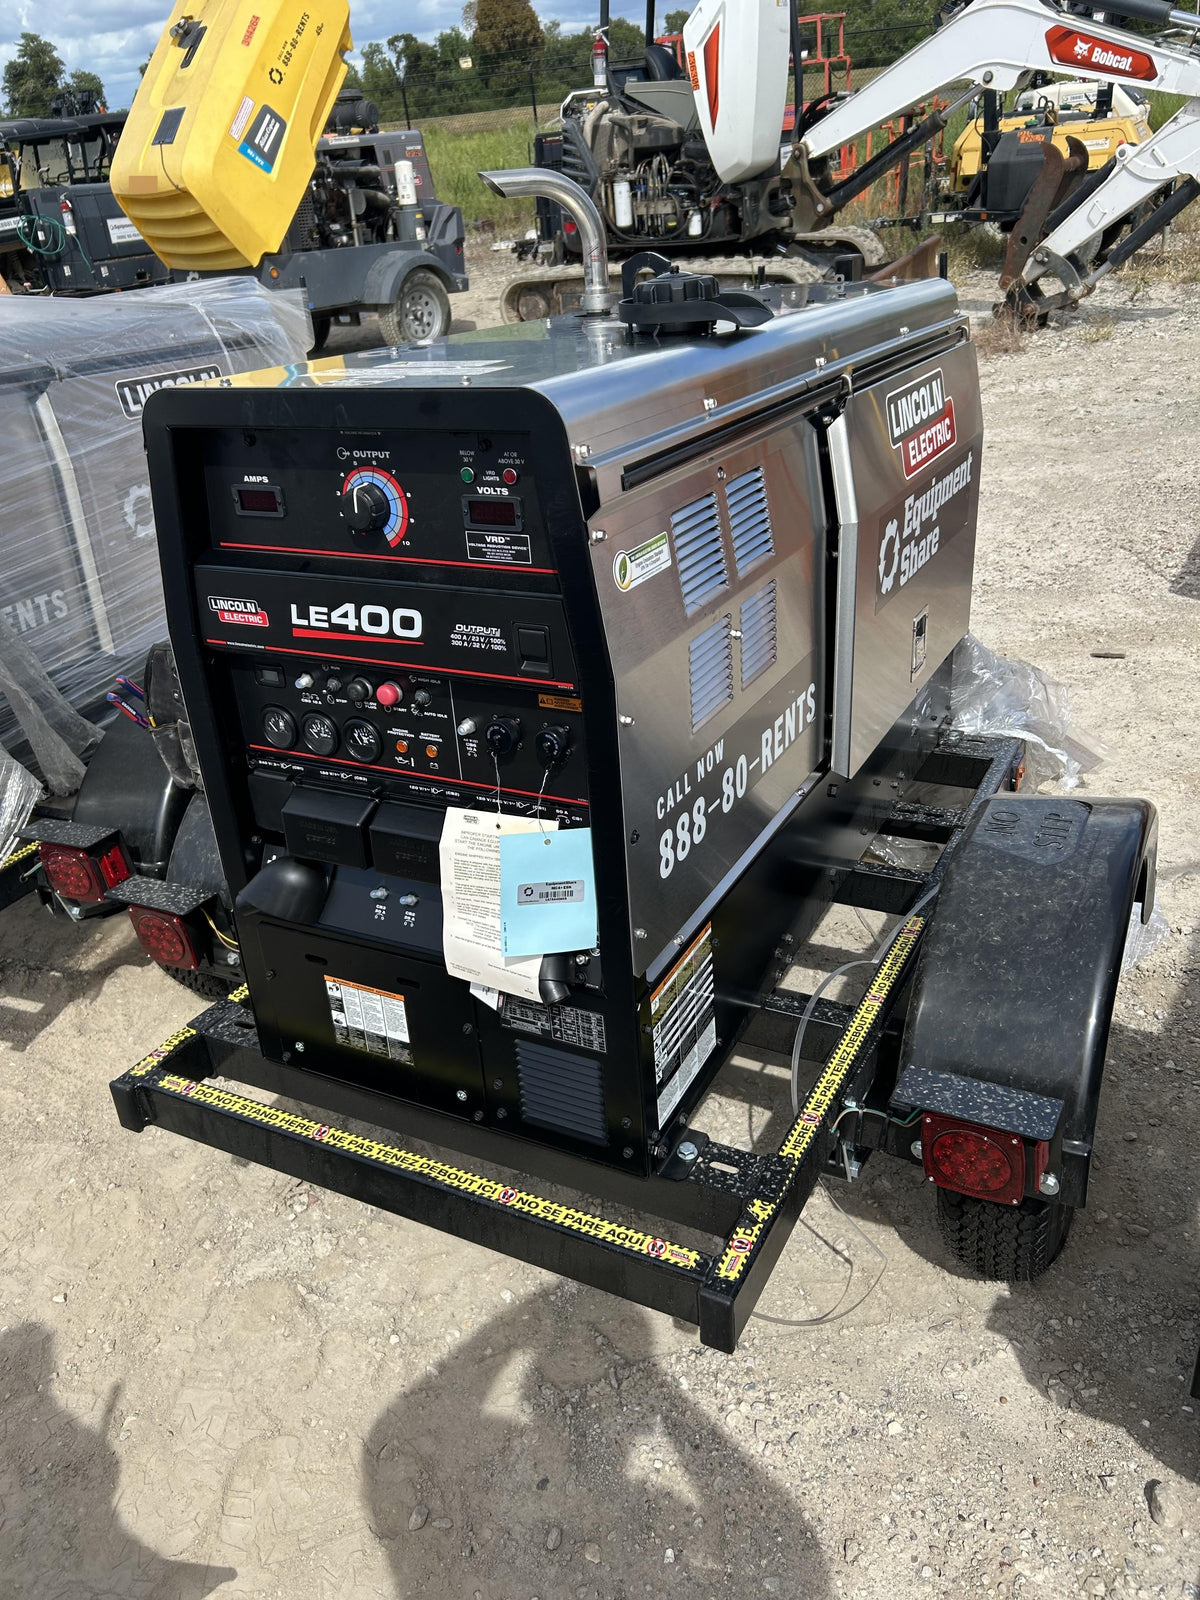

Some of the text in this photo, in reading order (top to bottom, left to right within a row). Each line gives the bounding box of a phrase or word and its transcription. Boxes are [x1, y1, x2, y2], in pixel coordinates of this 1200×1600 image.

[1091, 47, 1133, 72] Bobcat
[891, 377, 943, 438] LINCOLN
[908, 417, 951, 466] ELECTRIC
[353, 450, 390, 458] OUTPUT
[243, 475, 269, 483] AMPS
[476, 486, 509, 496] VOLTS
[902, 452, 972, 537] Equipment
[899, 526, 940, 587] Share
[210, 598, 256, 613] LINCOLN
[224, 612, 263, 624] ELECTRIC
[290, 603, 422, 638] LE400
[455, 624, 498, 636] OUTPUT
[656, 739, 724, 820] CALL NOW
[659, 683, 816, 879] 888-80-RENTS
[888, 951, 903, 971] PARE
[878, 981, 887, 994] NO
[884, 969, 893, 982] SE
[864, 1003, 875, 1018] ICI
[846, 1016, 868, 1049] DEBOUT
[831, 1048, 852, 1079] TENEZ
[822, 1077, 837, 1100] PAS
[814, 1099, 823, 1113] NE
[793, 1125, 812, 1150] HERE
[195, 1088, 213, 1100] DO
[216, 1093, 239, 1108] NOT
[239, 1101, 279, 1121] STAND
[279, 1113, 317, 1133] HERE
[329, 1132, 345, 1145] NE
[346, 1138, 376, 1153] PAS
[377, 1145, 420, 1167] TENEZ
[420, 1161, 477, 1188] DEBOUT
[477, 1178, 497, 1196] ICI
[516, 1196, 539, 1209] NO
[541, 1203, 563, 1218] SE
[563, 1210, 605, 1233] PARE
